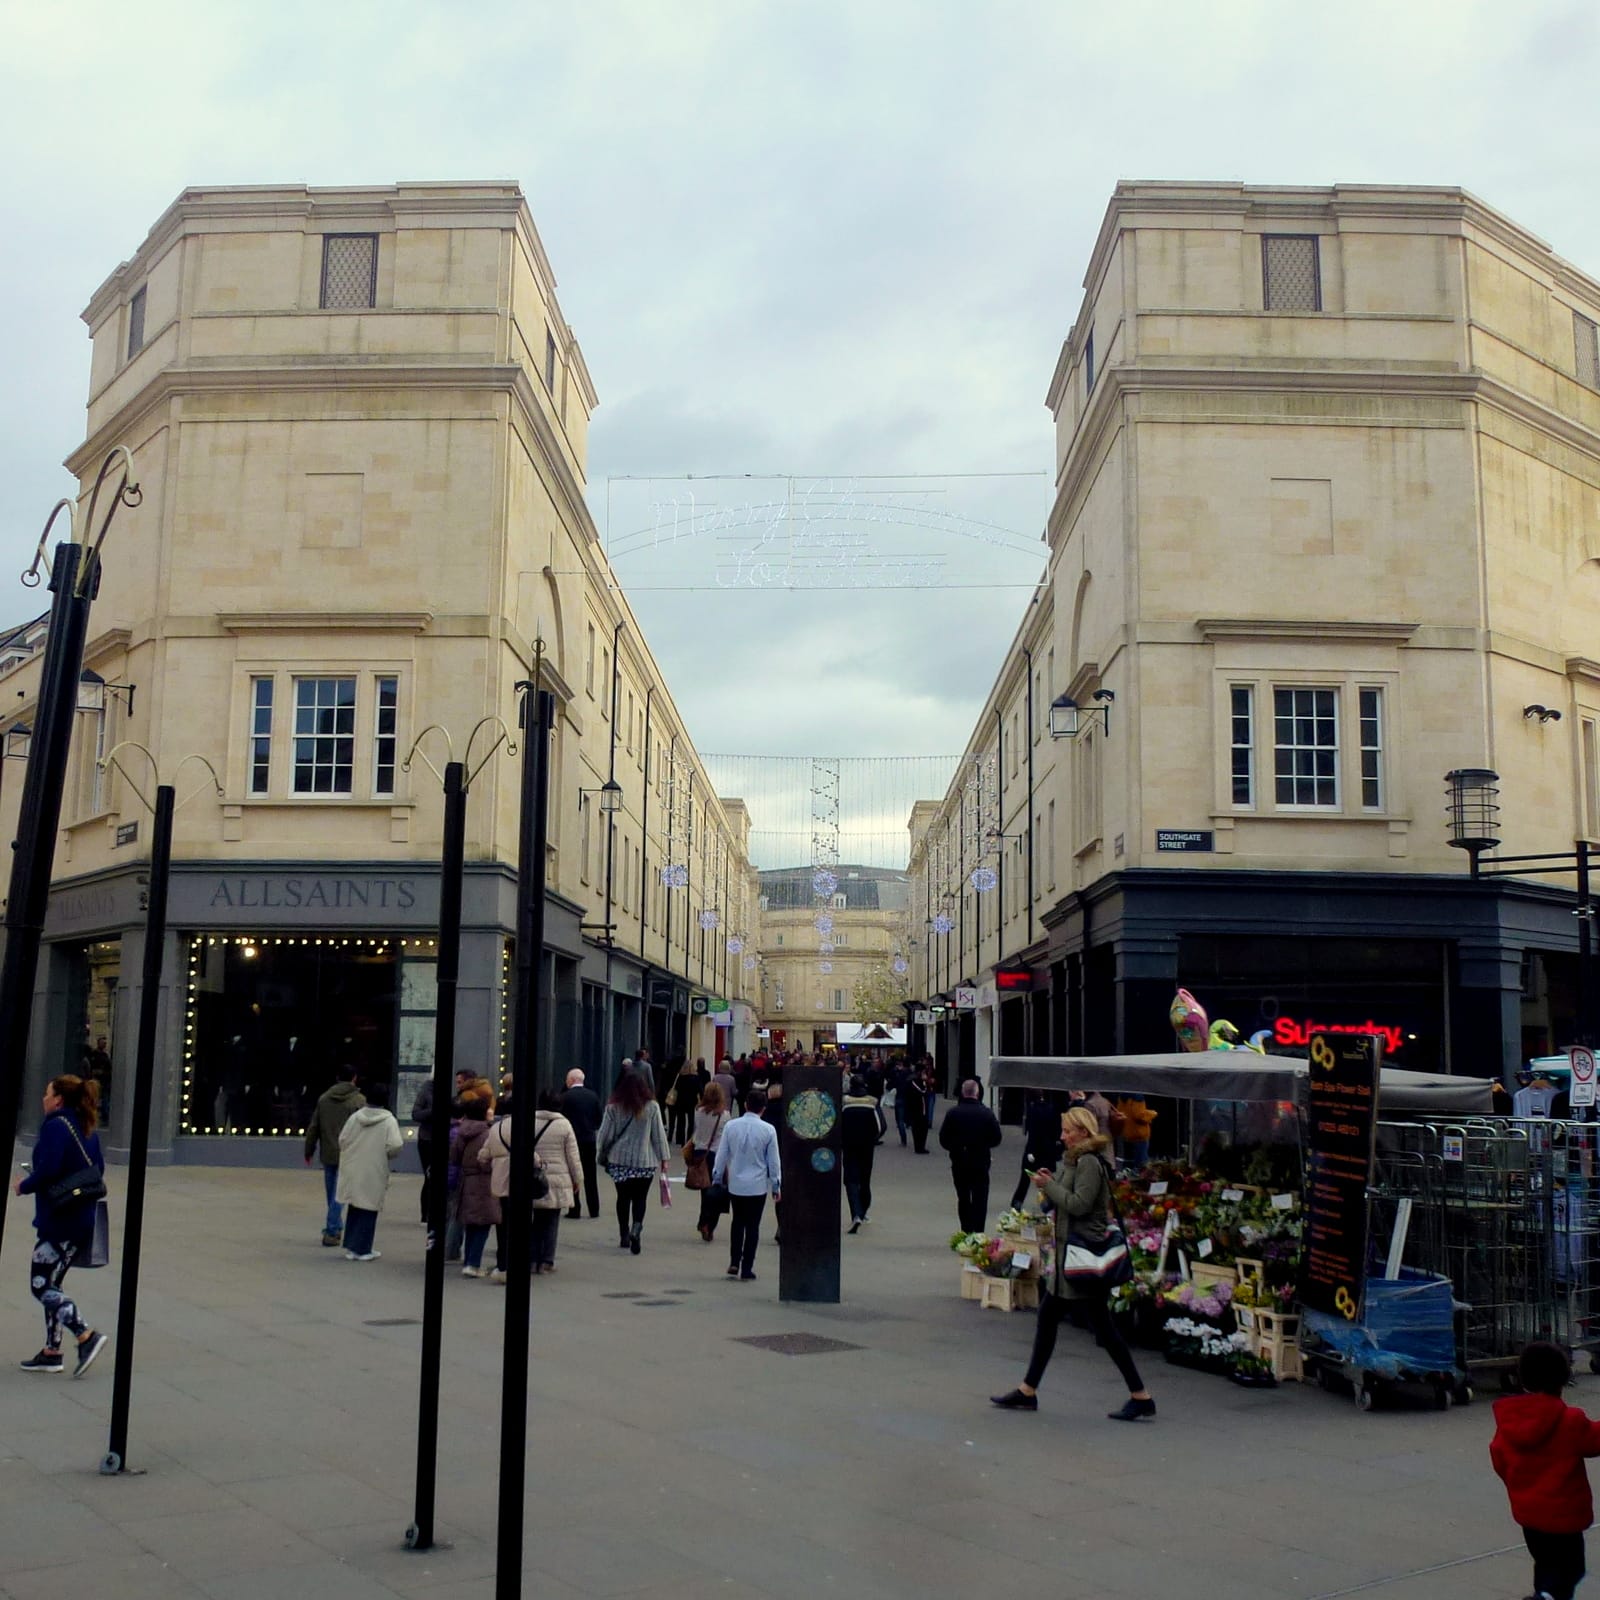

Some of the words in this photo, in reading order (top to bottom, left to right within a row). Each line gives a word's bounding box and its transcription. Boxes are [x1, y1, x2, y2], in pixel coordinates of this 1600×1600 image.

[1159, 833, 1201, 841] SOUTHGATE
[1159, 841, 1186, 849] STREET
[210, 878, 416, 910] ALLSAINTS
[1275, 1016, 1402, 1053] Sudry.
